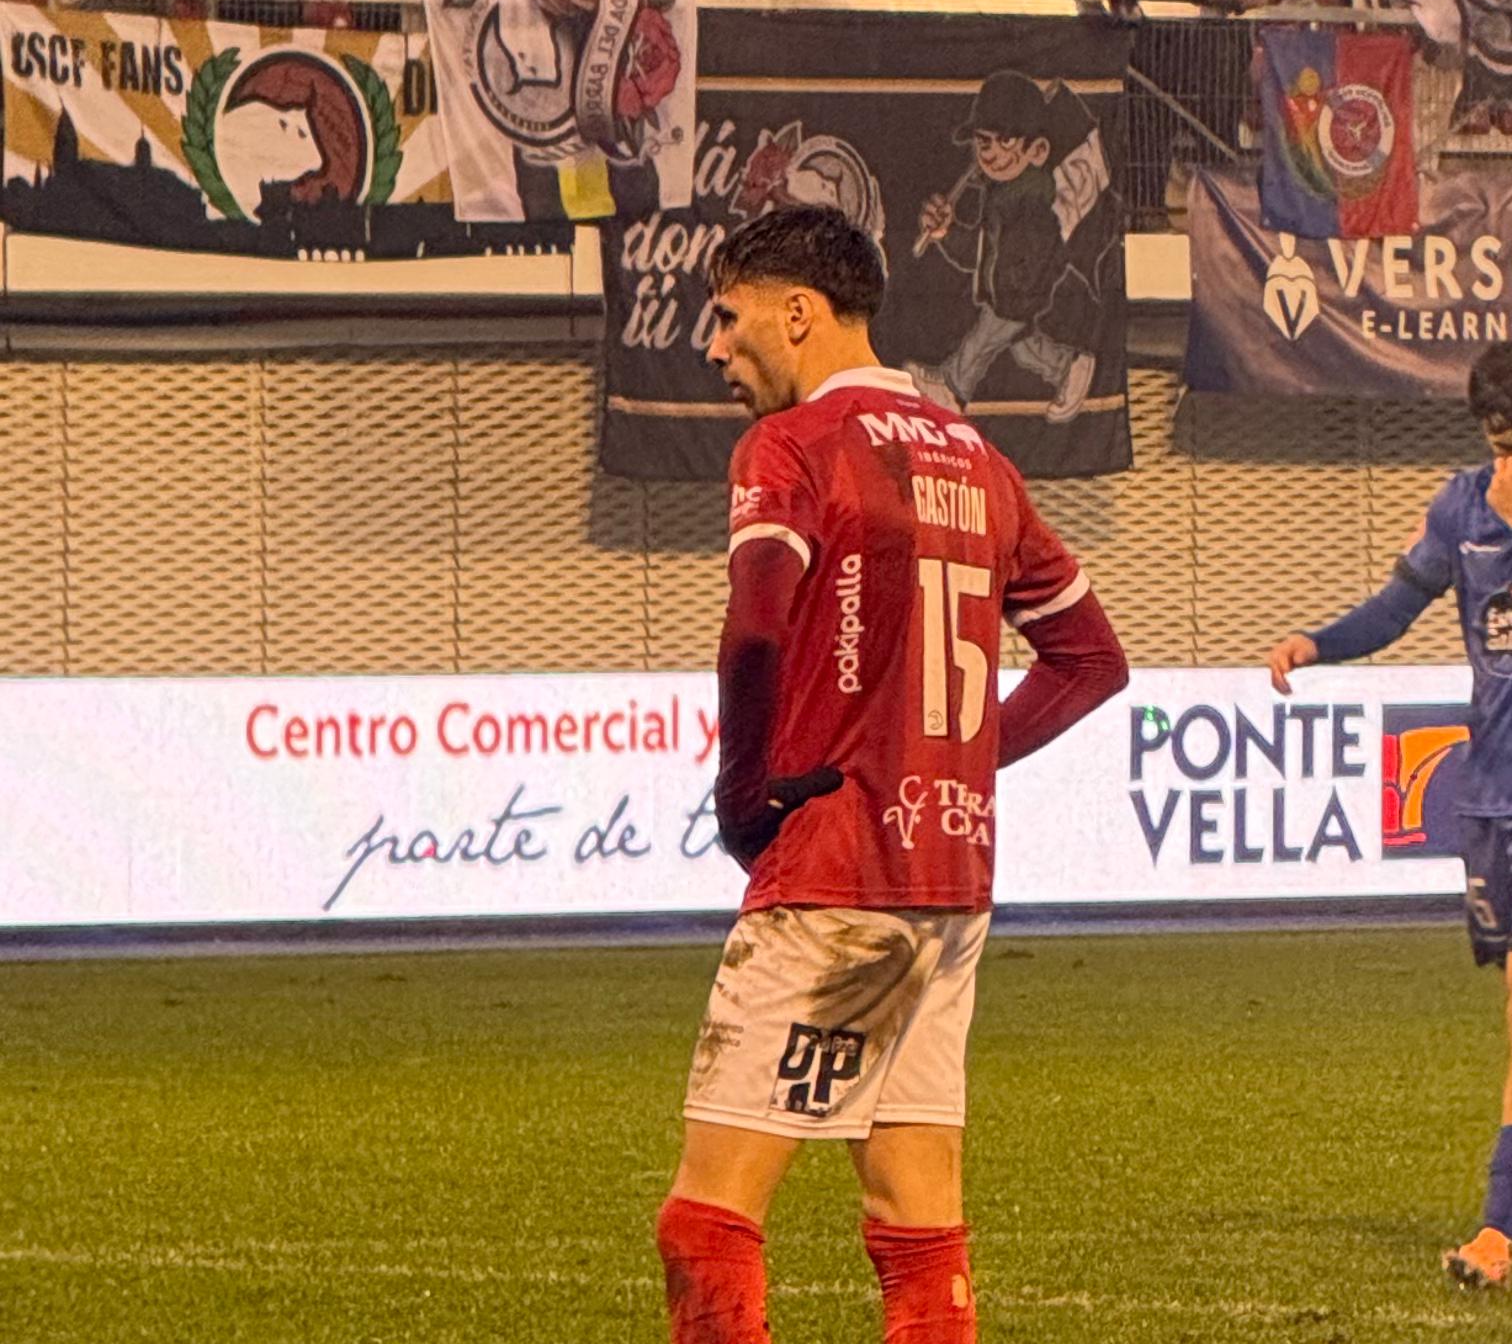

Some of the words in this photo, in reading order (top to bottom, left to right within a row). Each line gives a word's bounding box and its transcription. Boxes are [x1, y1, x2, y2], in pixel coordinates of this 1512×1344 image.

[101, 39, 185, 96] FANS
[911, 475, 987, 536] GASTÓN
[917, 557, 991, 744] 15
[246, 703, 418, 760] Centro
[437, 694, 680, 756] Comercial
[1129, 703, 1367, 781] PONTE
[322, 784, 563, 911] parte
[574, 795, 652, 864] de
[1129, 787, 1363, 868] VELLA
